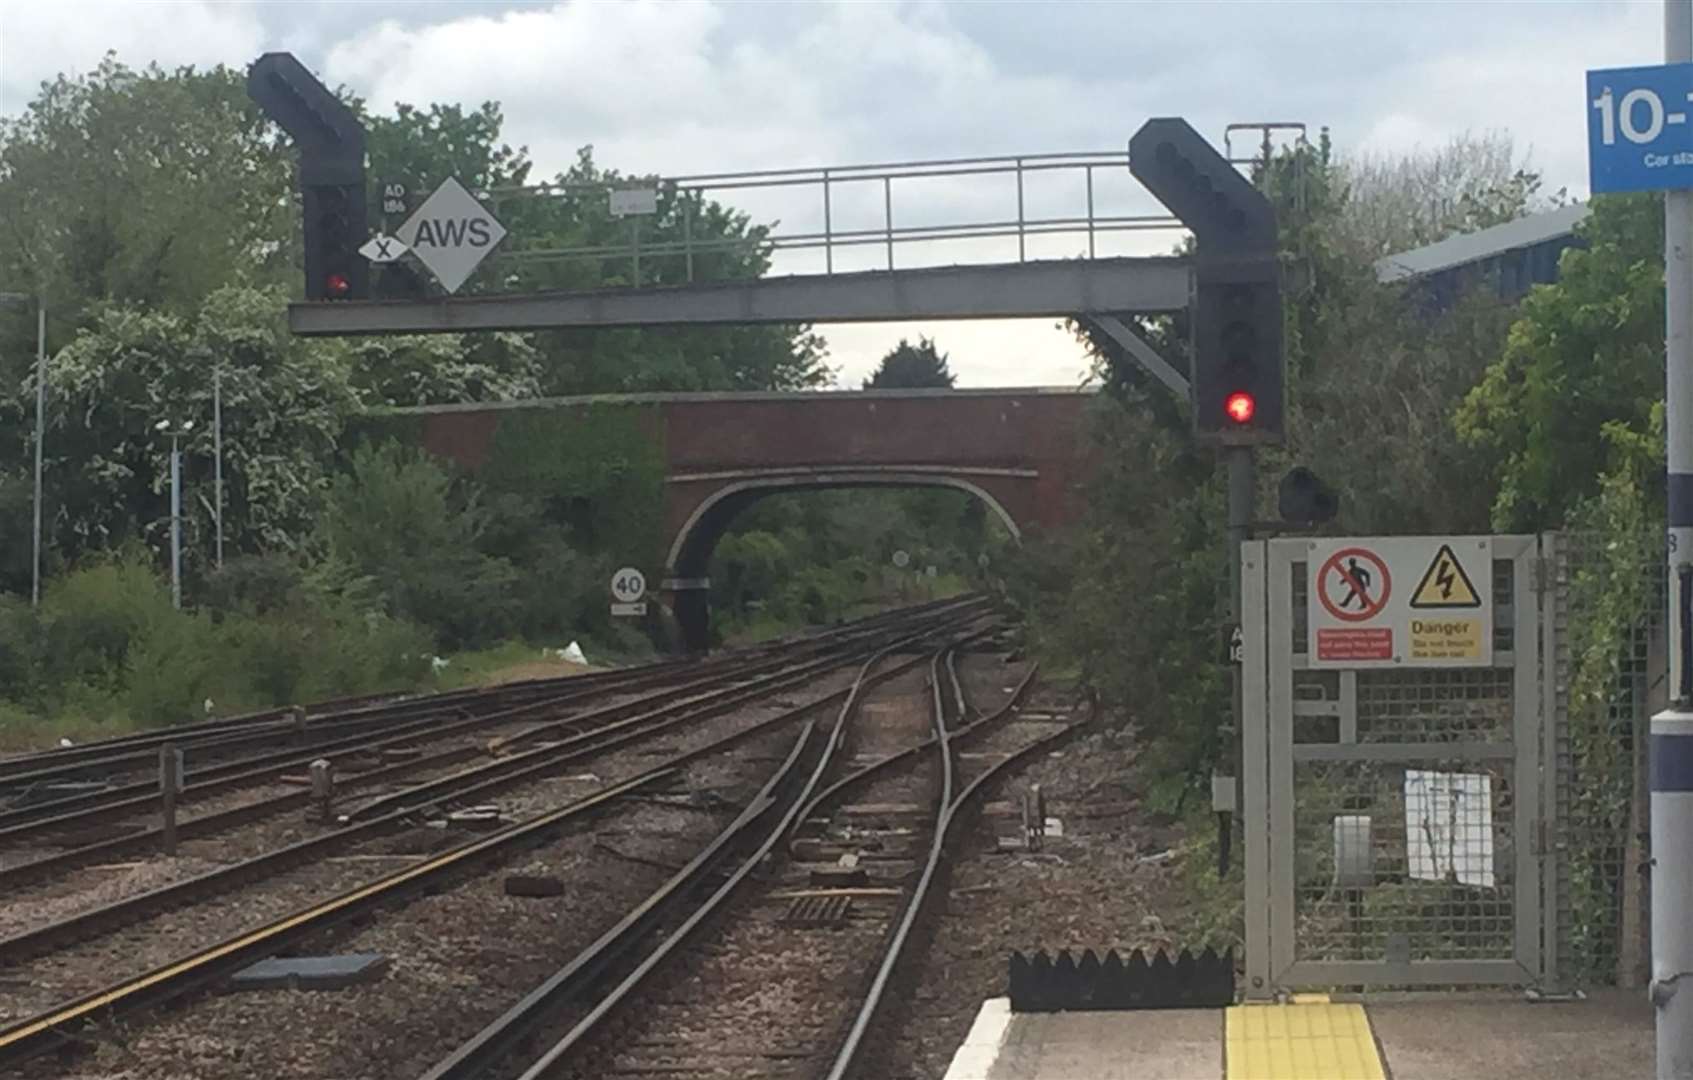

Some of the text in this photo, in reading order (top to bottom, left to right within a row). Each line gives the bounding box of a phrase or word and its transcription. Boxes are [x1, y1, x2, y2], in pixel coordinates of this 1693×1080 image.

[1593, 86, 1693, 145] 10-
[1644, 153, 1669, 168] Car
[384, 183, 405, 197] AD
[412, 218, 491, 247] AWS
[376, 241, 391, 258] X
[616, 576, 641, 594] 40
[1412, 621, 1470, 636] Danger
